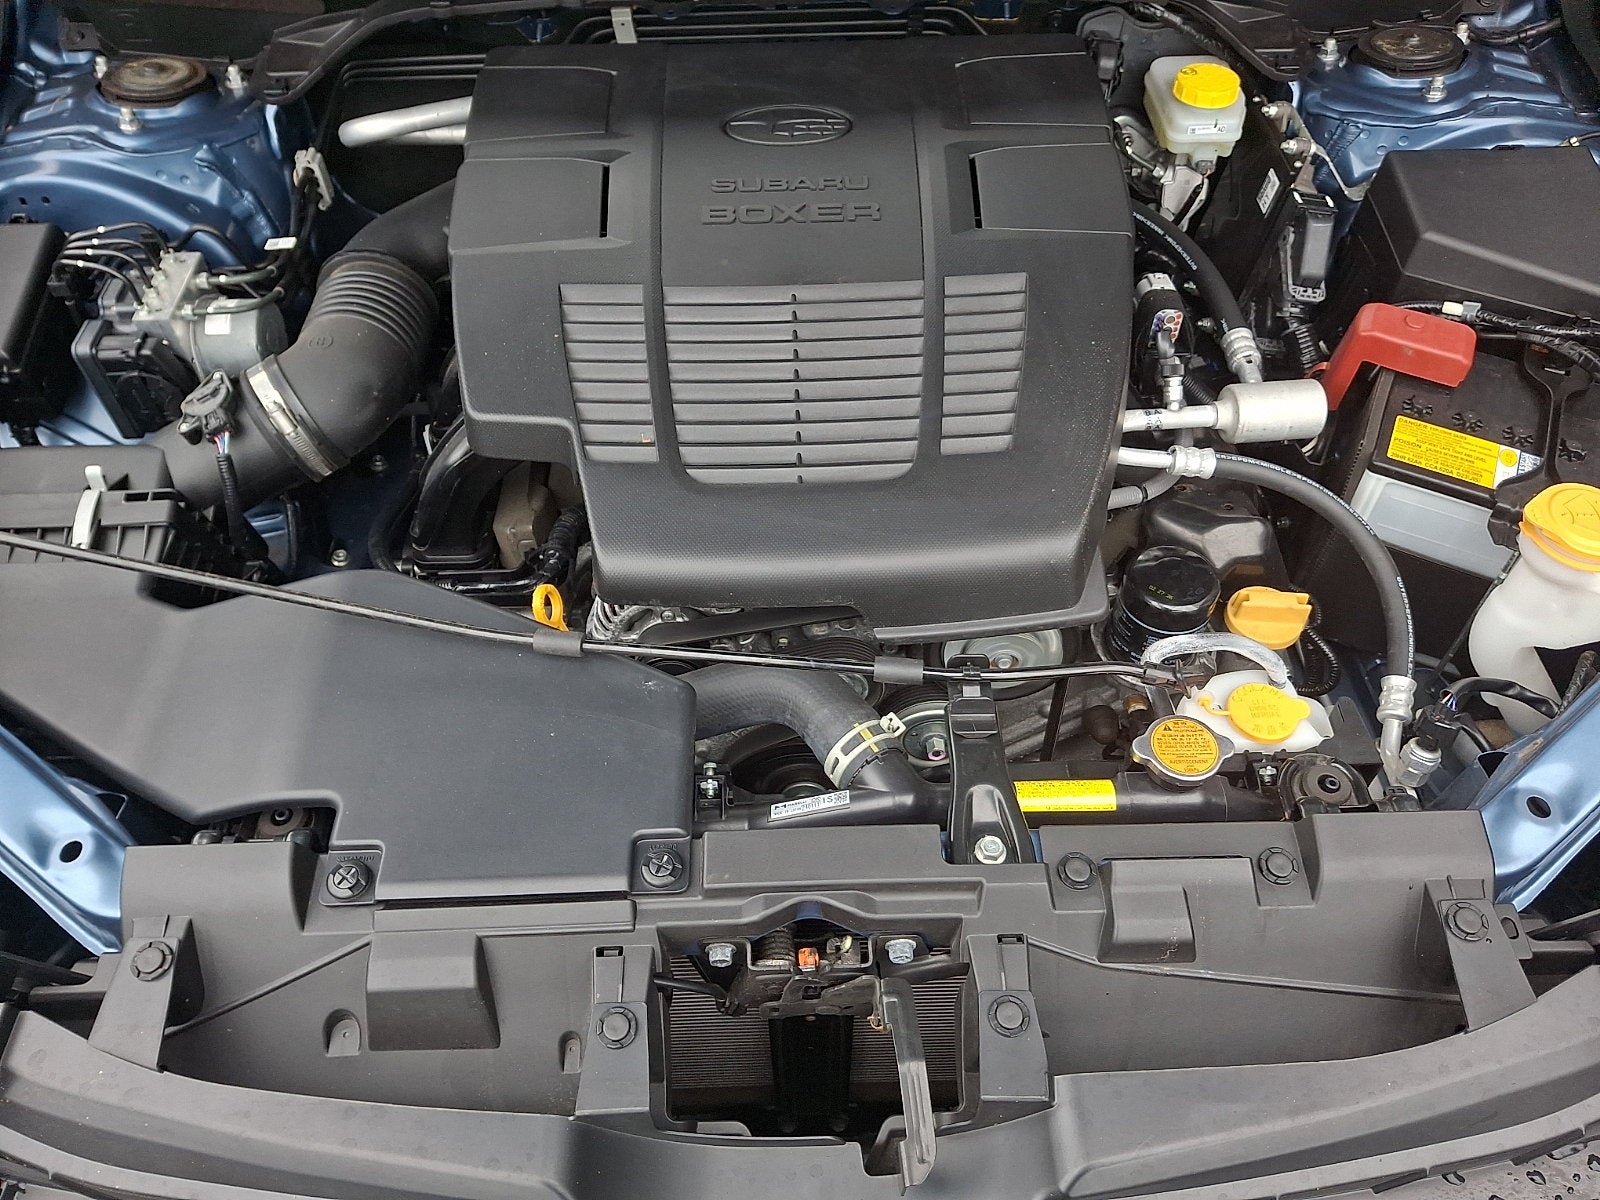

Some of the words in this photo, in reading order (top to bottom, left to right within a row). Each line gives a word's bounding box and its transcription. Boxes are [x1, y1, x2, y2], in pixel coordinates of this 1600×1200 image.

[710, 175, 870, 193] SUBARU
[701, 202, 881, 225] BOXER
[1399, 417, 1428, 429] DANGER
[1394, 437, 1422, 449] POISON
